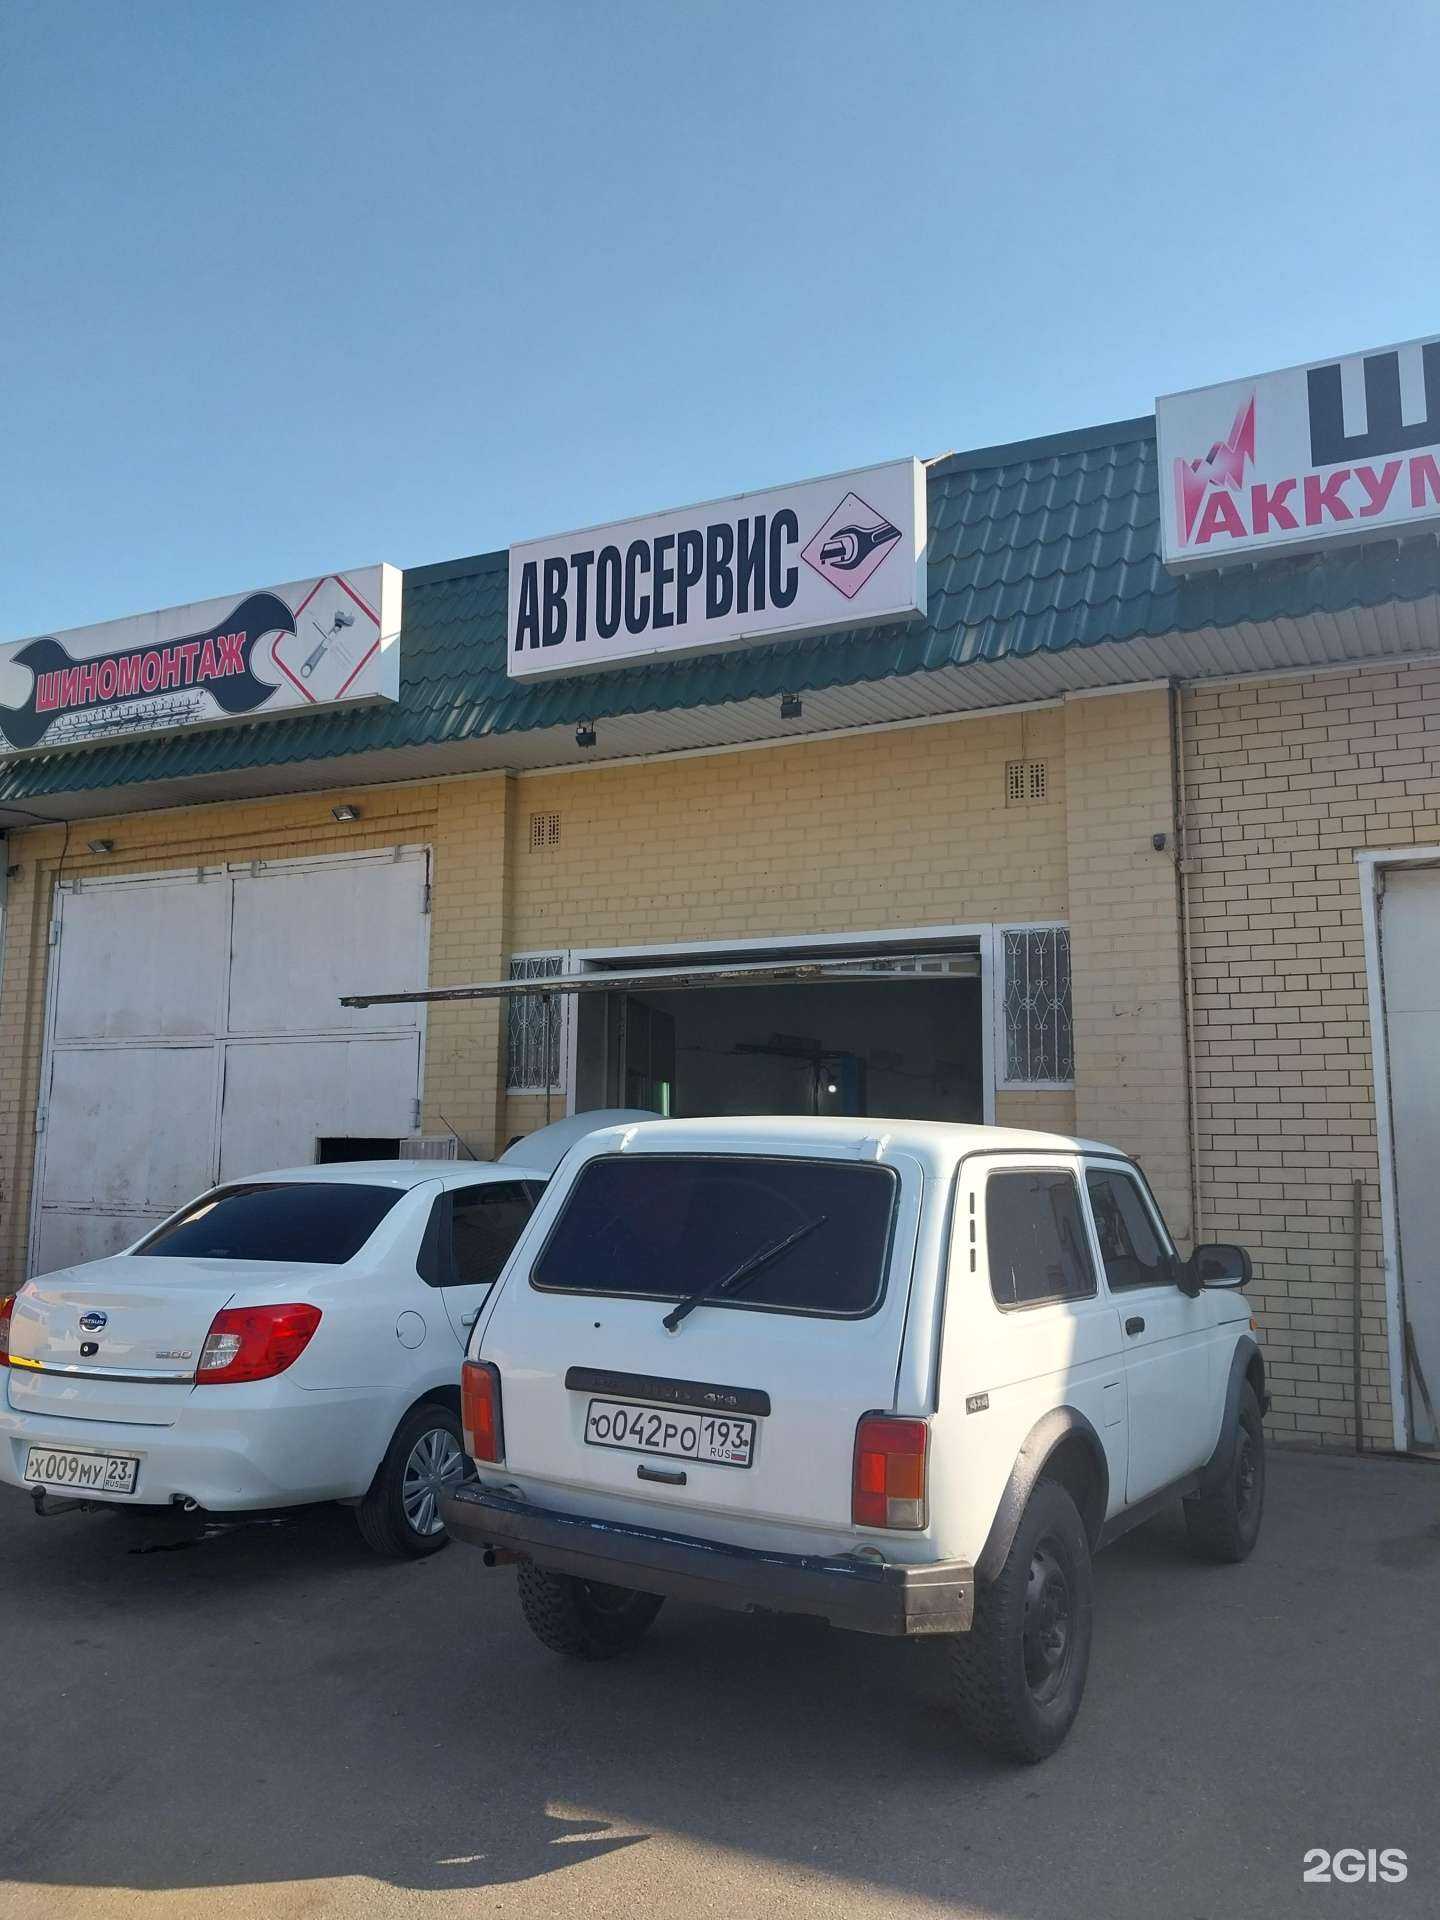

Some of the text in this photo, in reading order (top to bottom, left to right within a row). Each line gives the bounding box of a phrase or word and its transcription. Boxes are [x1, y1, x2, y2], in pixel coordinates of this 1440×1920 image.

[514, 508, 799, 651] АВТОСЕРВИС
[35, 631, 247, 712] ШИНОМОНТАЖ
[704, 1420, 745, 1449] 193
[710, 1447, 731, 1459] RUS
[107, 1460, 128, 1480] 23
[105, 1479, 120, 1488] RUS
